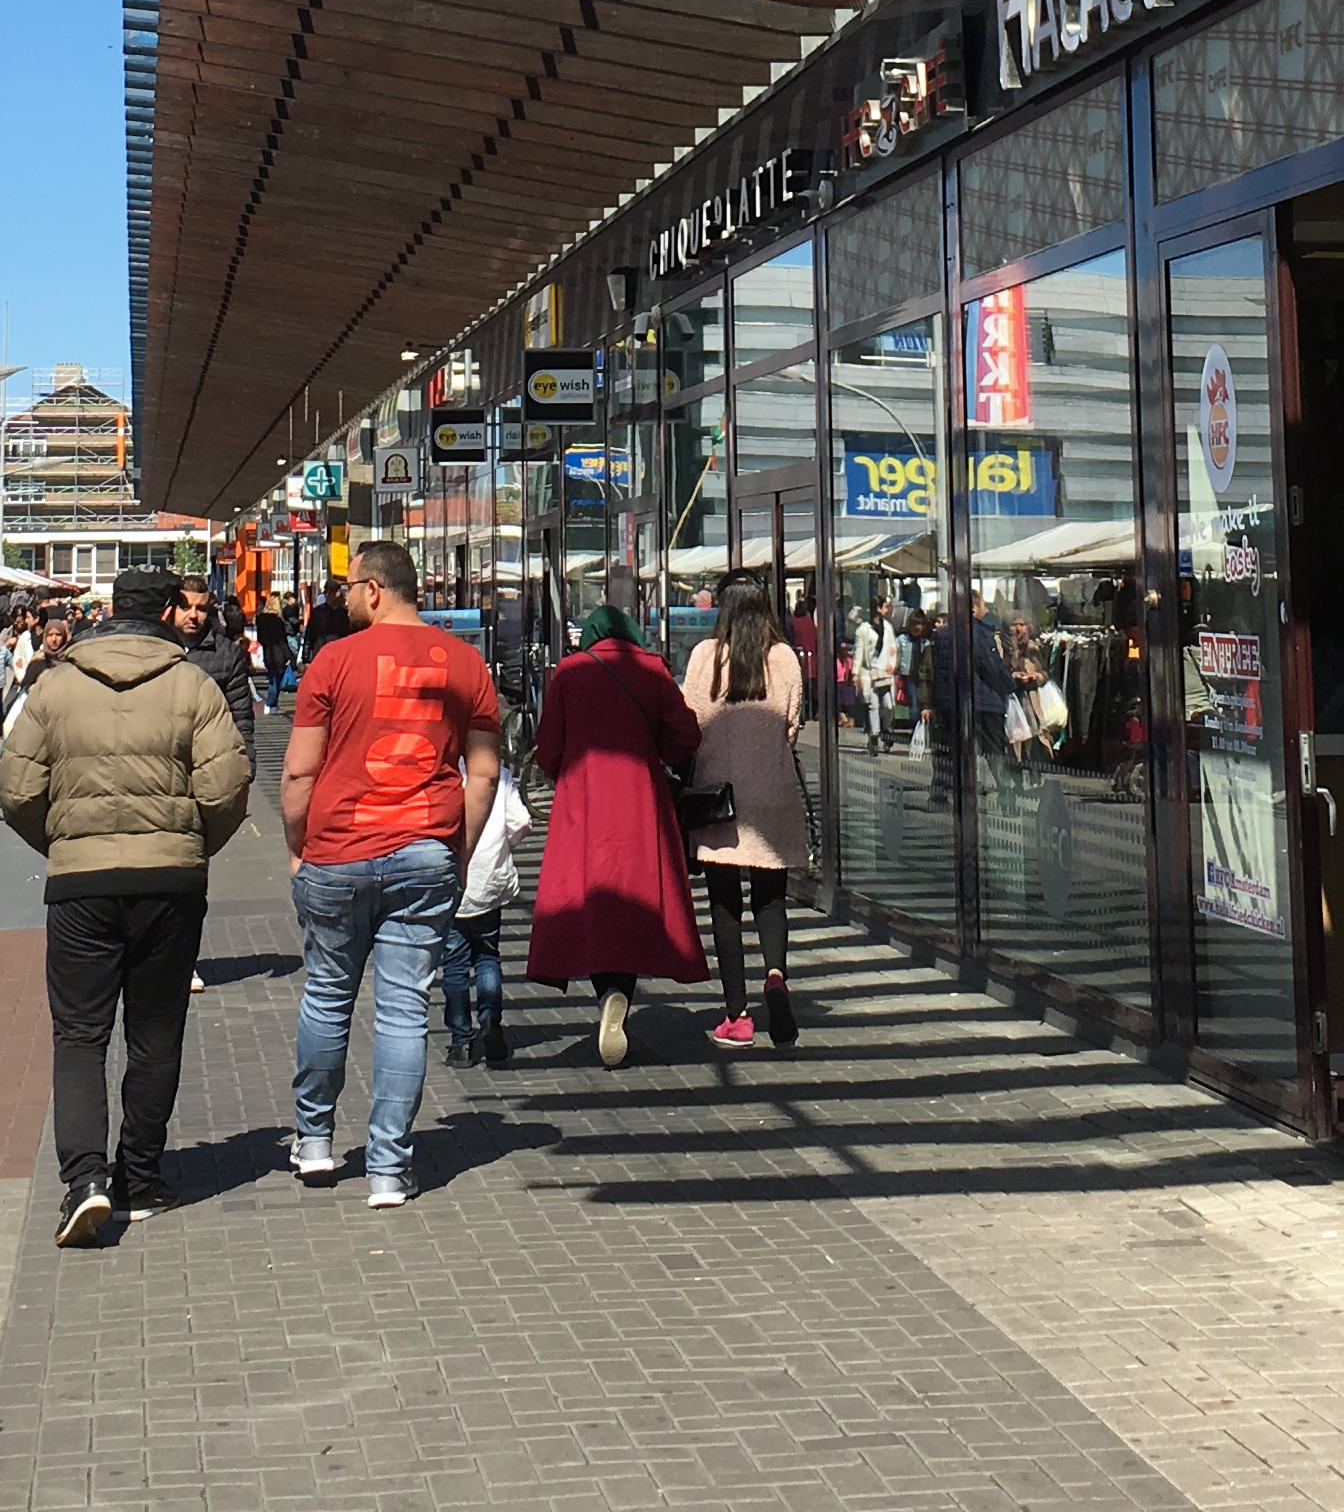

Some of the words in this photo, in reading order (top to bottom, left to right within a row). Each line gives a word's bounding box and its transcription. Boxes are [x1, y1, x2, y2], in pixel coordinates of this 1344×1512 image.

[533, 382, 557, 395] eye
[559, 378, 590, 391] wish
[1210, 420, 1230, 446] HFC
[1223, 534, 1261, 597] tasty
[1200, 634, 1260, 678] ENTREE
[354, 733, 437, 825] DO
